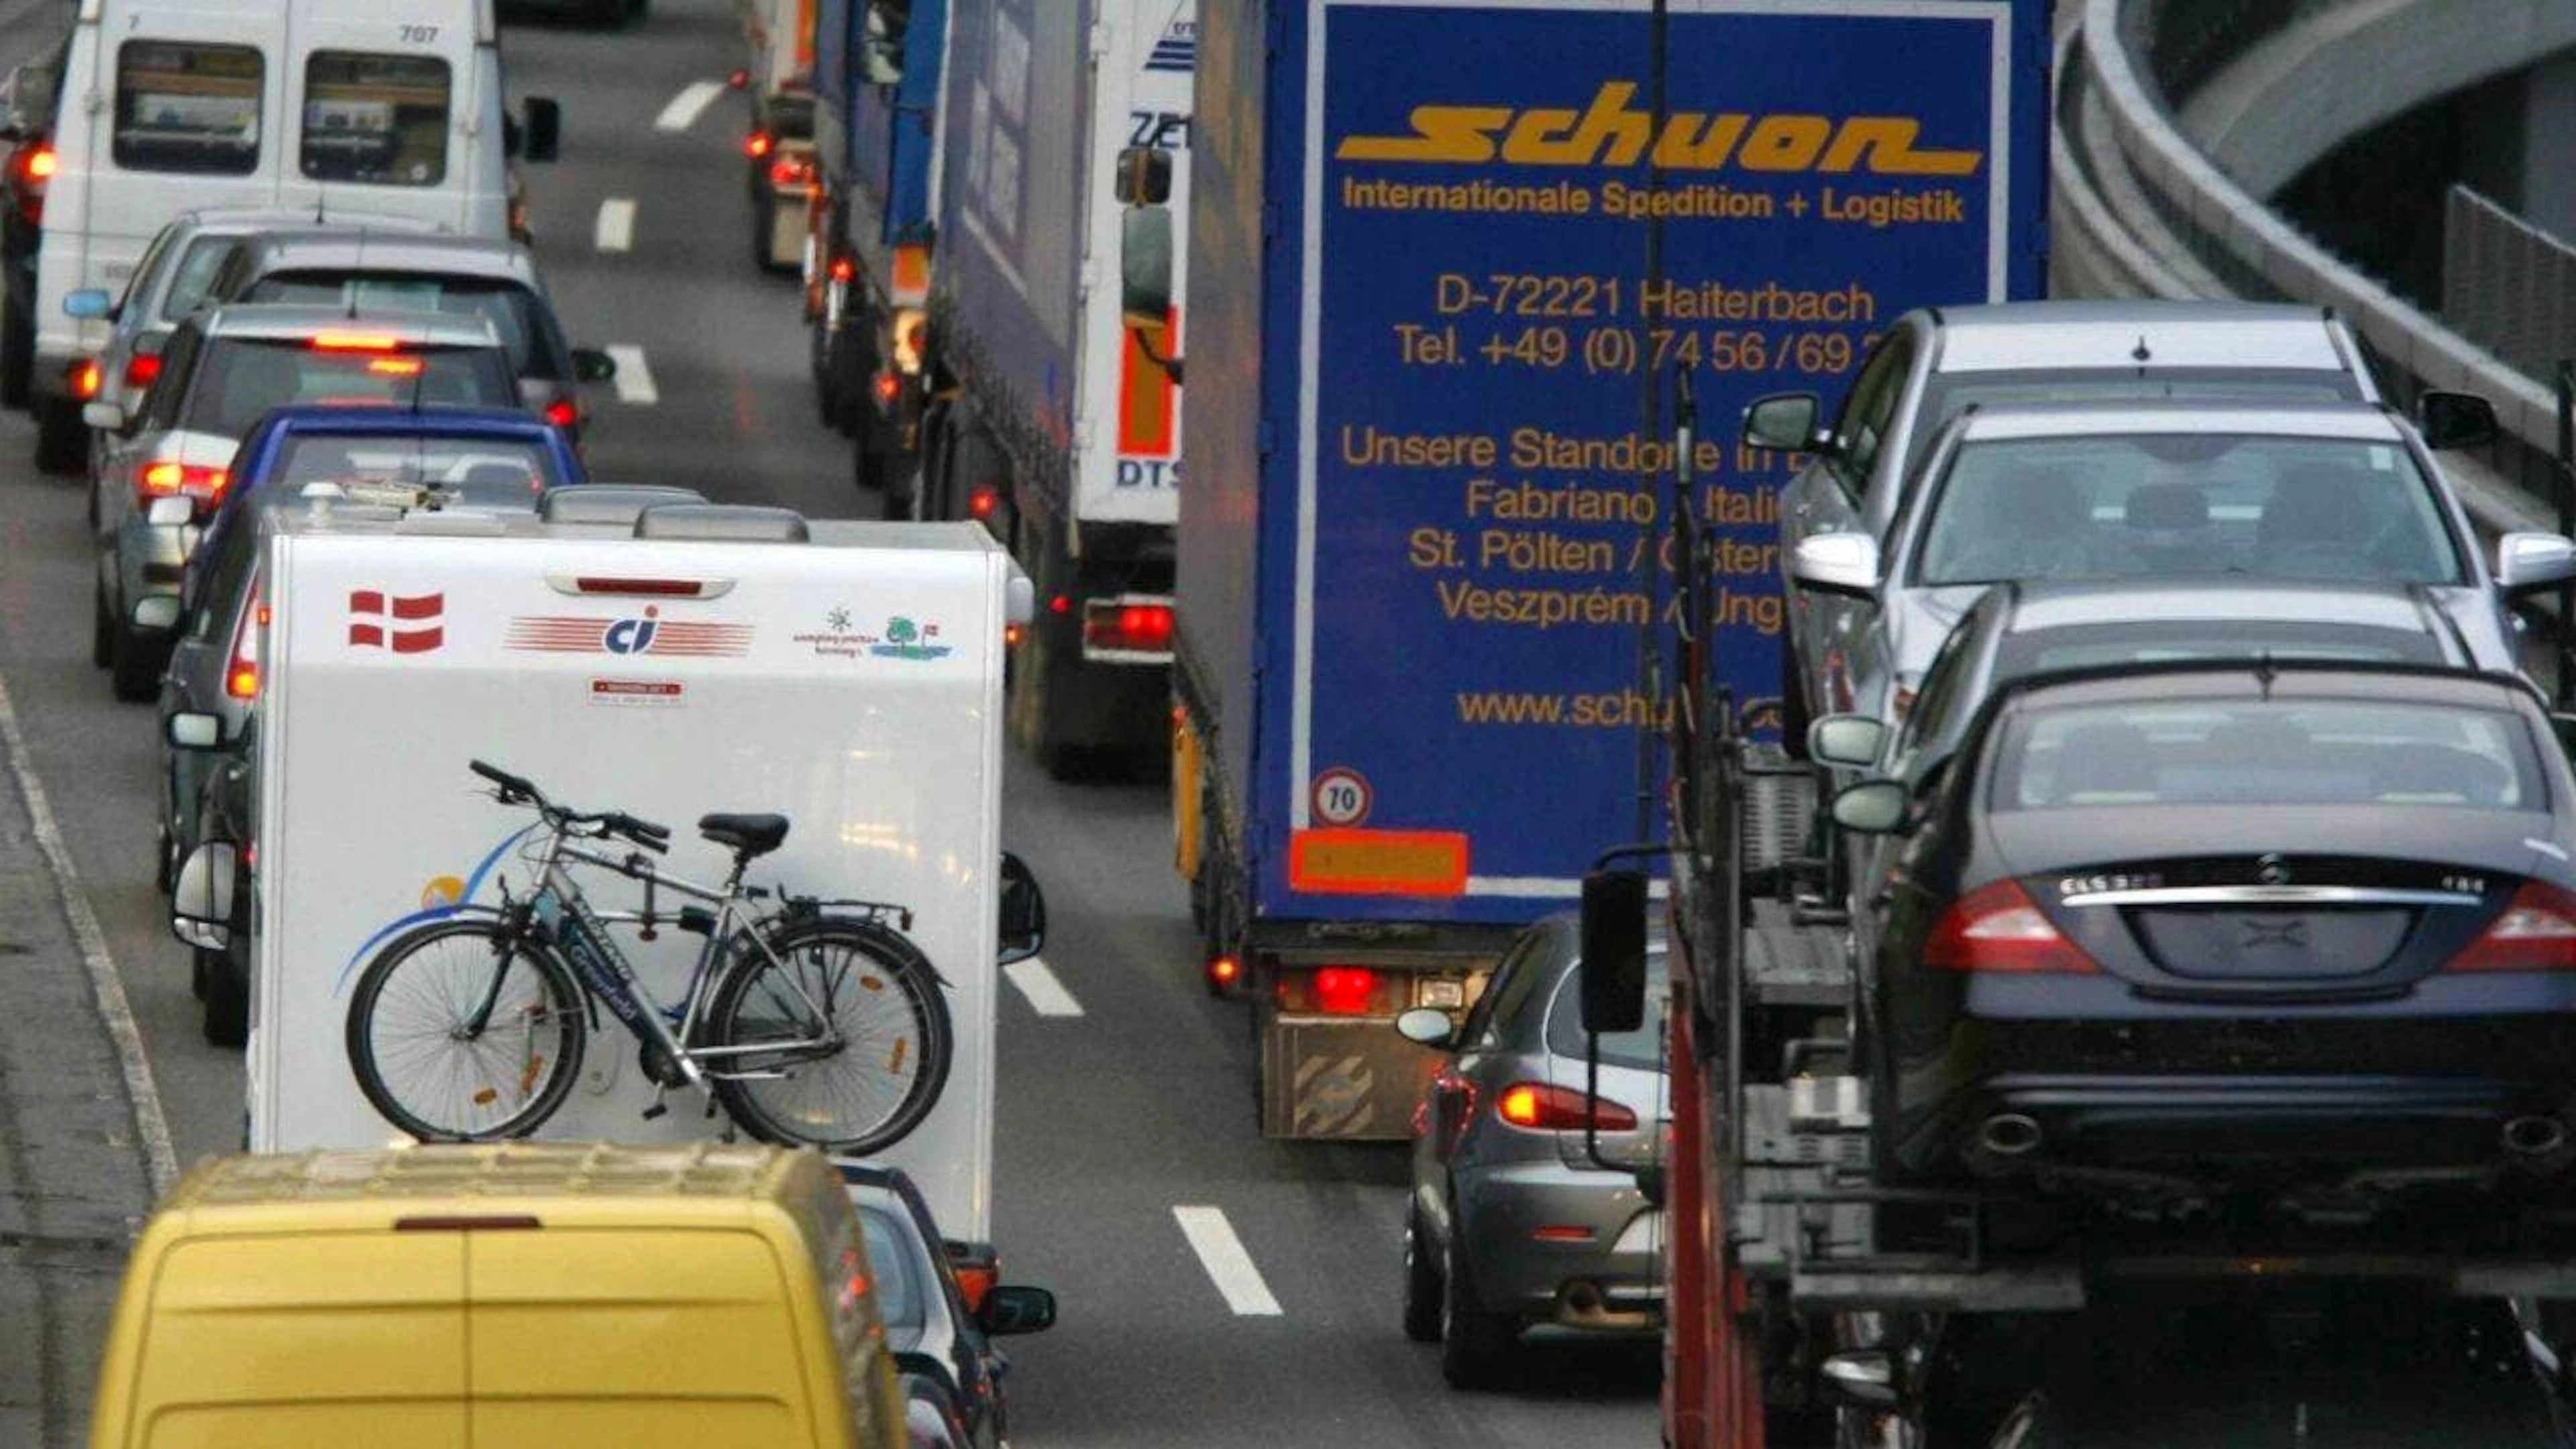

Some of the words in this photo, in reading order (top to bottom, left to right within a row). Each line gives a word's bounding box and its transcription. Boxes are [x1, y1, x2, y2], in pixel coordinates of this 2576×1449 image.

[398, 25, 438, 42] 707
[1335, 81, 1982, 174] schuon
[1343, 177, 1591, 214] Internationale
[1601, 182, 1772, 221] Spedition
[1786, 193, 1809, 217] +
[1823, 188, 1964, 227] Logistik
[1438, 274, 1619, 316] D-72221
[1640, 278, 1874, 321] Haiterbach
[1393, 325, 1466, 364] Tel.
[1481, 327, 1568, 366] +49
[1585, 327, 1635, 374] (0)
[1343, 425, 1497, 468] Unsere
[1509, 427, 1721, 472] Standore
[1467, 478, 1656, 525] Fabriano
[1705, 483, 1782, 523] Itali
[1409, 528, 1465, 568] St.
[1481, 529, 1613, 571] Pölten
[1437, 579, 1652, 629] Veszprém
[1329, 786, 1356, 811] 70
